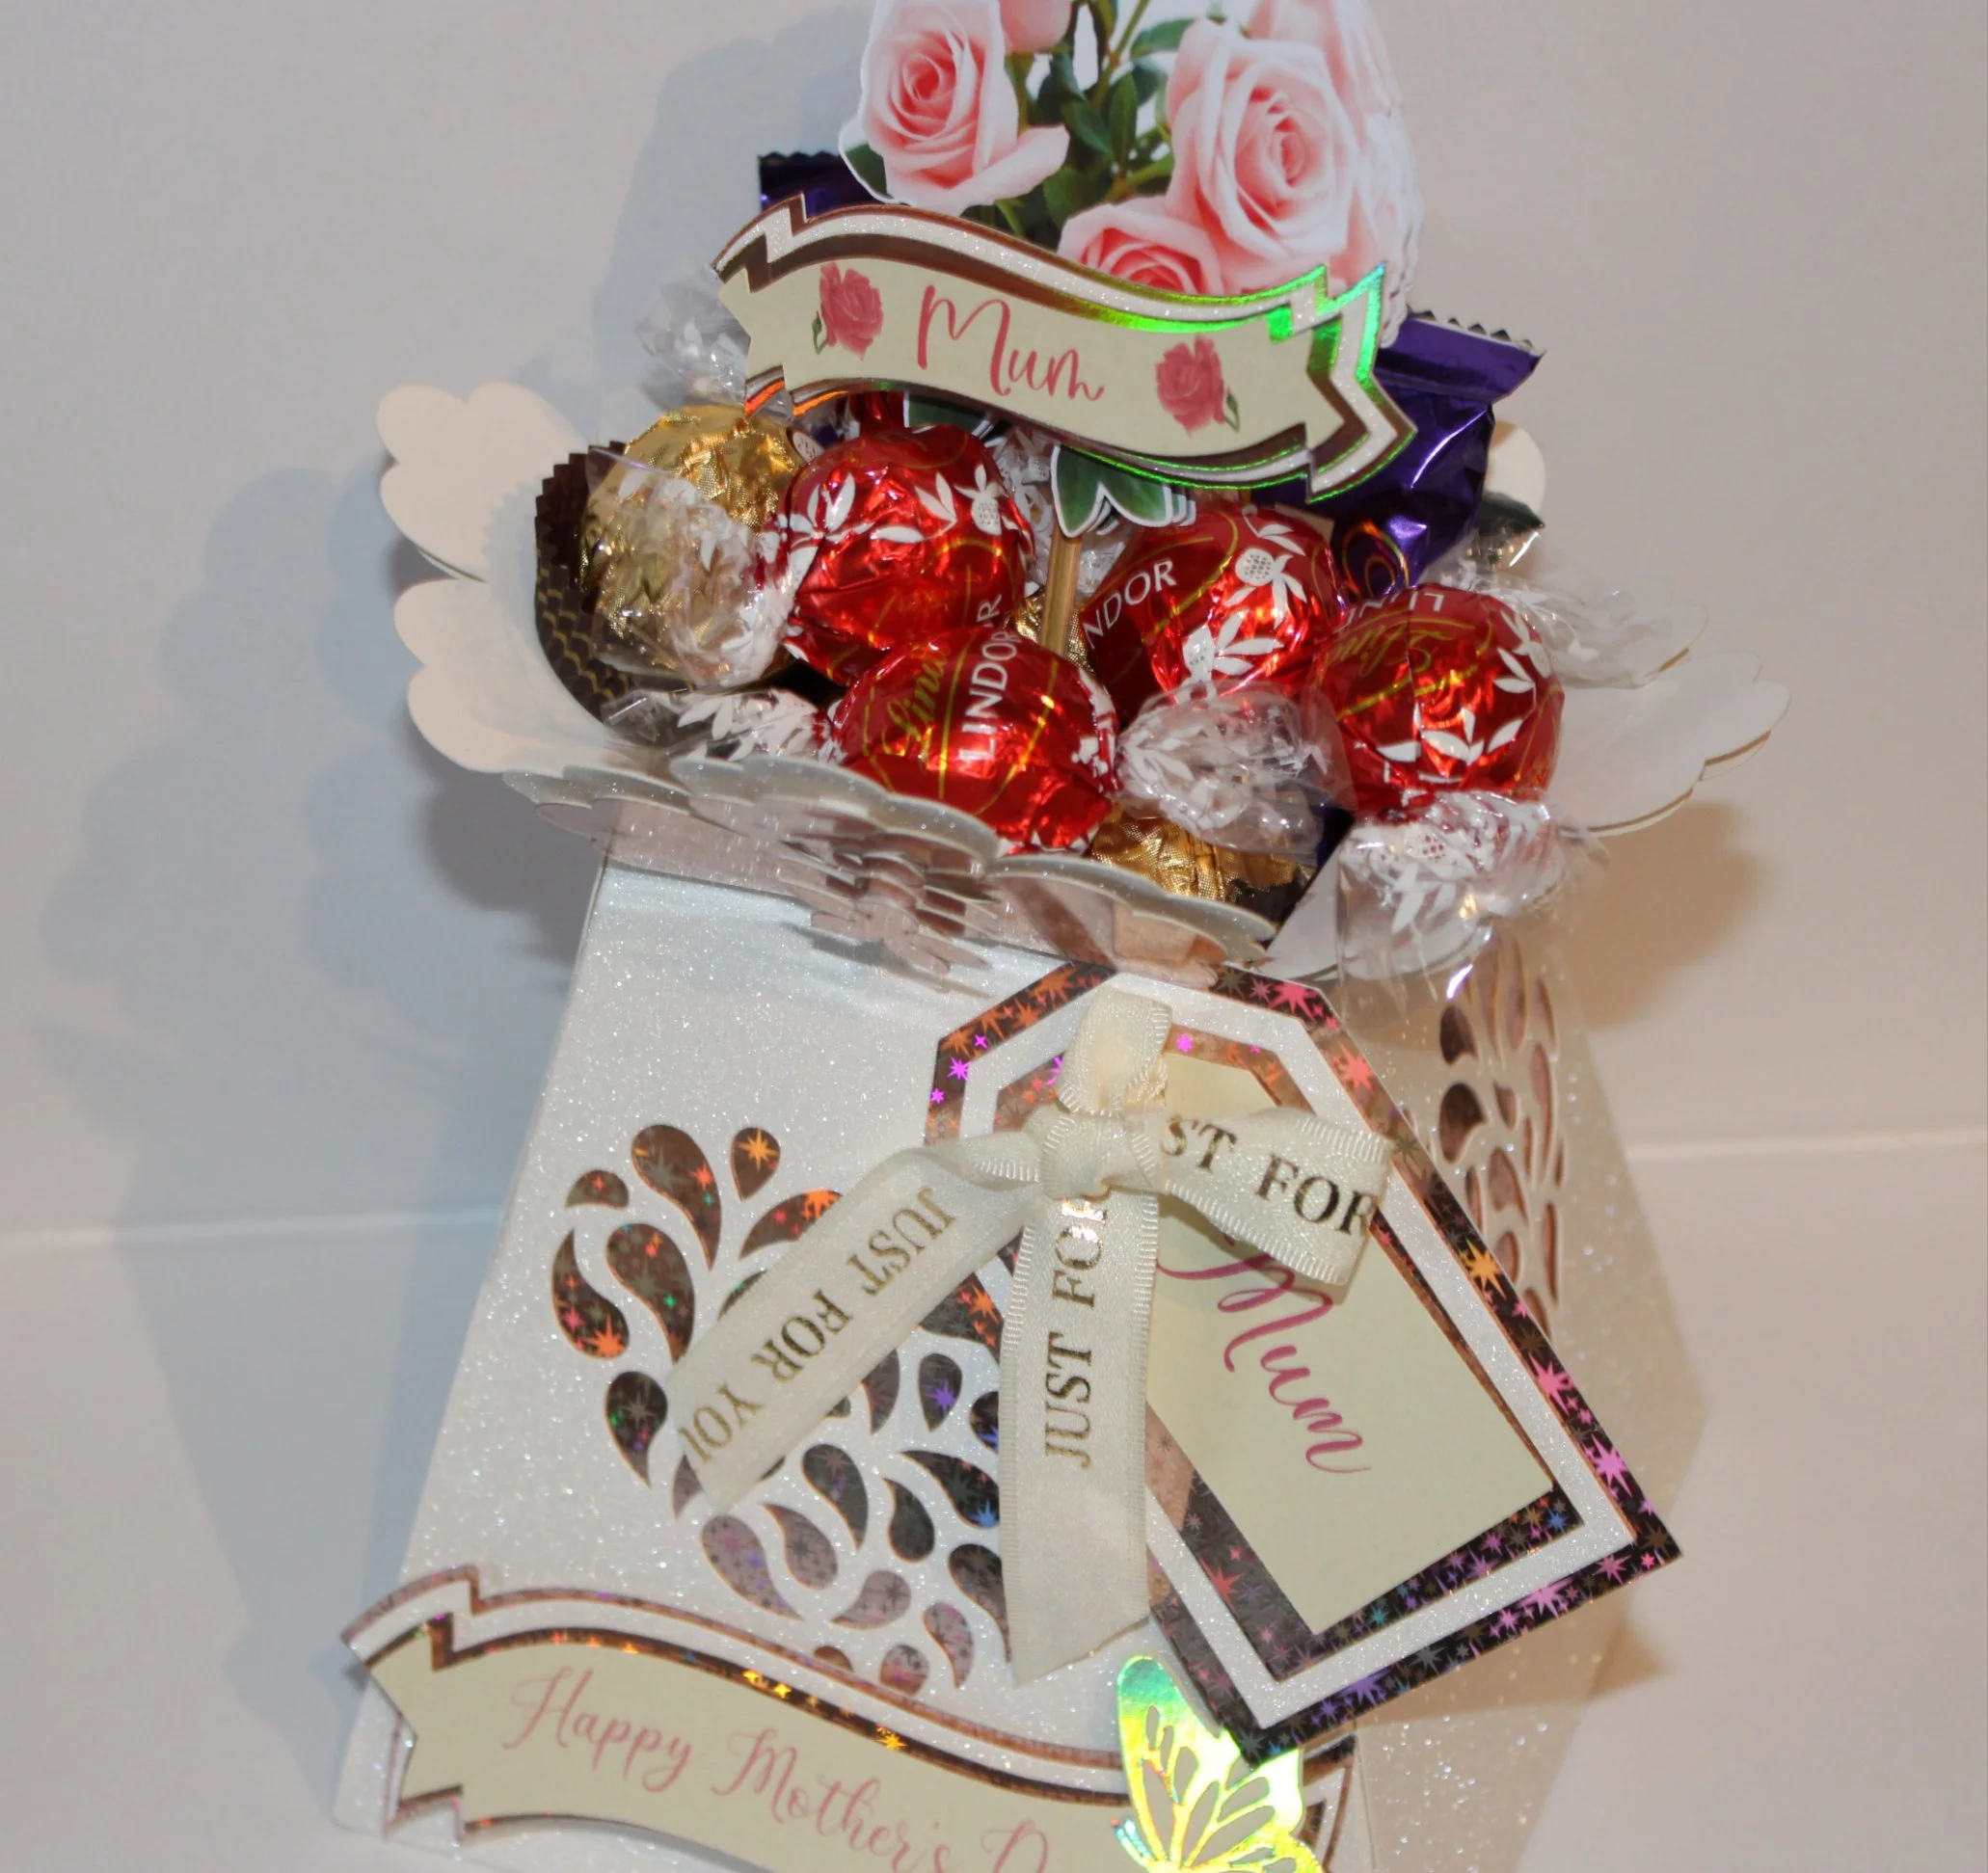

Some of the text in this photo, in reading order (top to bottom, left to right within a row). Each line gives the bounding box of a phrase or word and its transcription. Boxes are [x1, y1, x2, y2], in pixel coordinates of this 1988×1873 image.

[917, 284, 1105, 402] Mum
[1082, 559, 1178, 651] NDOR
[958, 630, 1023, 762] LINDOR
[1161, 1114, 1238, 1174] ST
[846, 1187, 956, 1297] JUST
[750, 1289, 855, 1383] FOR
[1156, 1235, 1373, 1475] Mum
[1044, 1330, 1093, 1471] JUST
[503, 1666, 693, 1793] Happy
